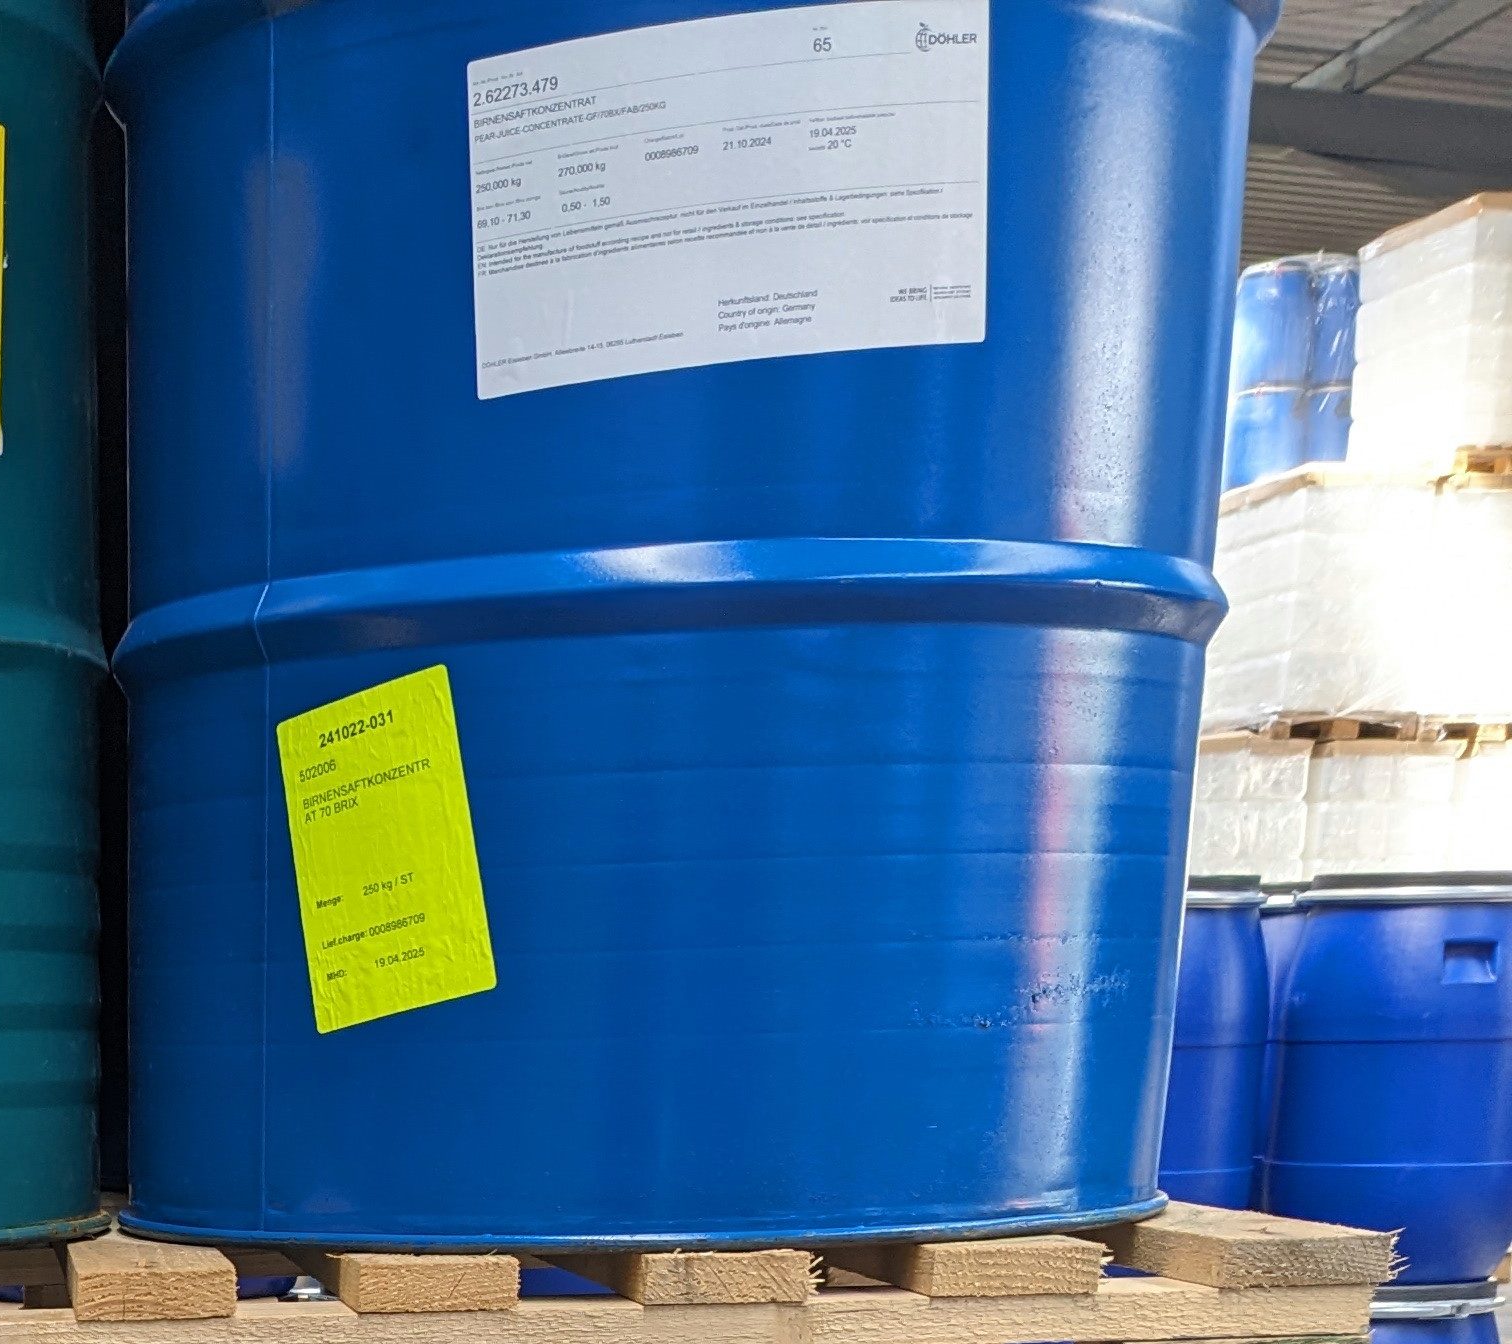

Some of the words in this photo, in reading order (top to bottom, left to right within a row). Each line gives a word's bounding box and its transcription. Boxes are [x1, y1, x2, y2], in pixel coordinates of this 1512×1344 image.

[813, 37, 832, 52] 65
[928, 32, 978, 46] DÖHLER
[473, 76, 559, 107] 2.62273.479
[474, 95, 597, 129] BIRNENSAFTKONZENTRAT
[722, 136, 772, 151] 21.10.2024
[809, 126, 857, 139] 19.04.2025
[827, 140, 839, 150] 20
[595, 162, 606, 172] kg
[511, 177, 522, 188] kg
[773, 289, 818, 301] Deutschland
[718, 308, 746, 320] Country
[782, 302, 816, 314] Germany
[318, 709, 393, 749] 241022-031
[299, 759, 337, 783] 502006
[303, 758, 431, 810] BIRNENSAFTKONZENTR
[305, 810, 316, 824] AT
[320, 805, 331, 818] 70
[334, 796, 359, 814] BRIX
[363, 882, 379, 896] 250
[381, 880, 393, 892] kg
[400, 872, 414, 885] ST
[369, 912, 426, 937] 0008986709
[374, 946, 425, 969] 19.04.2025
